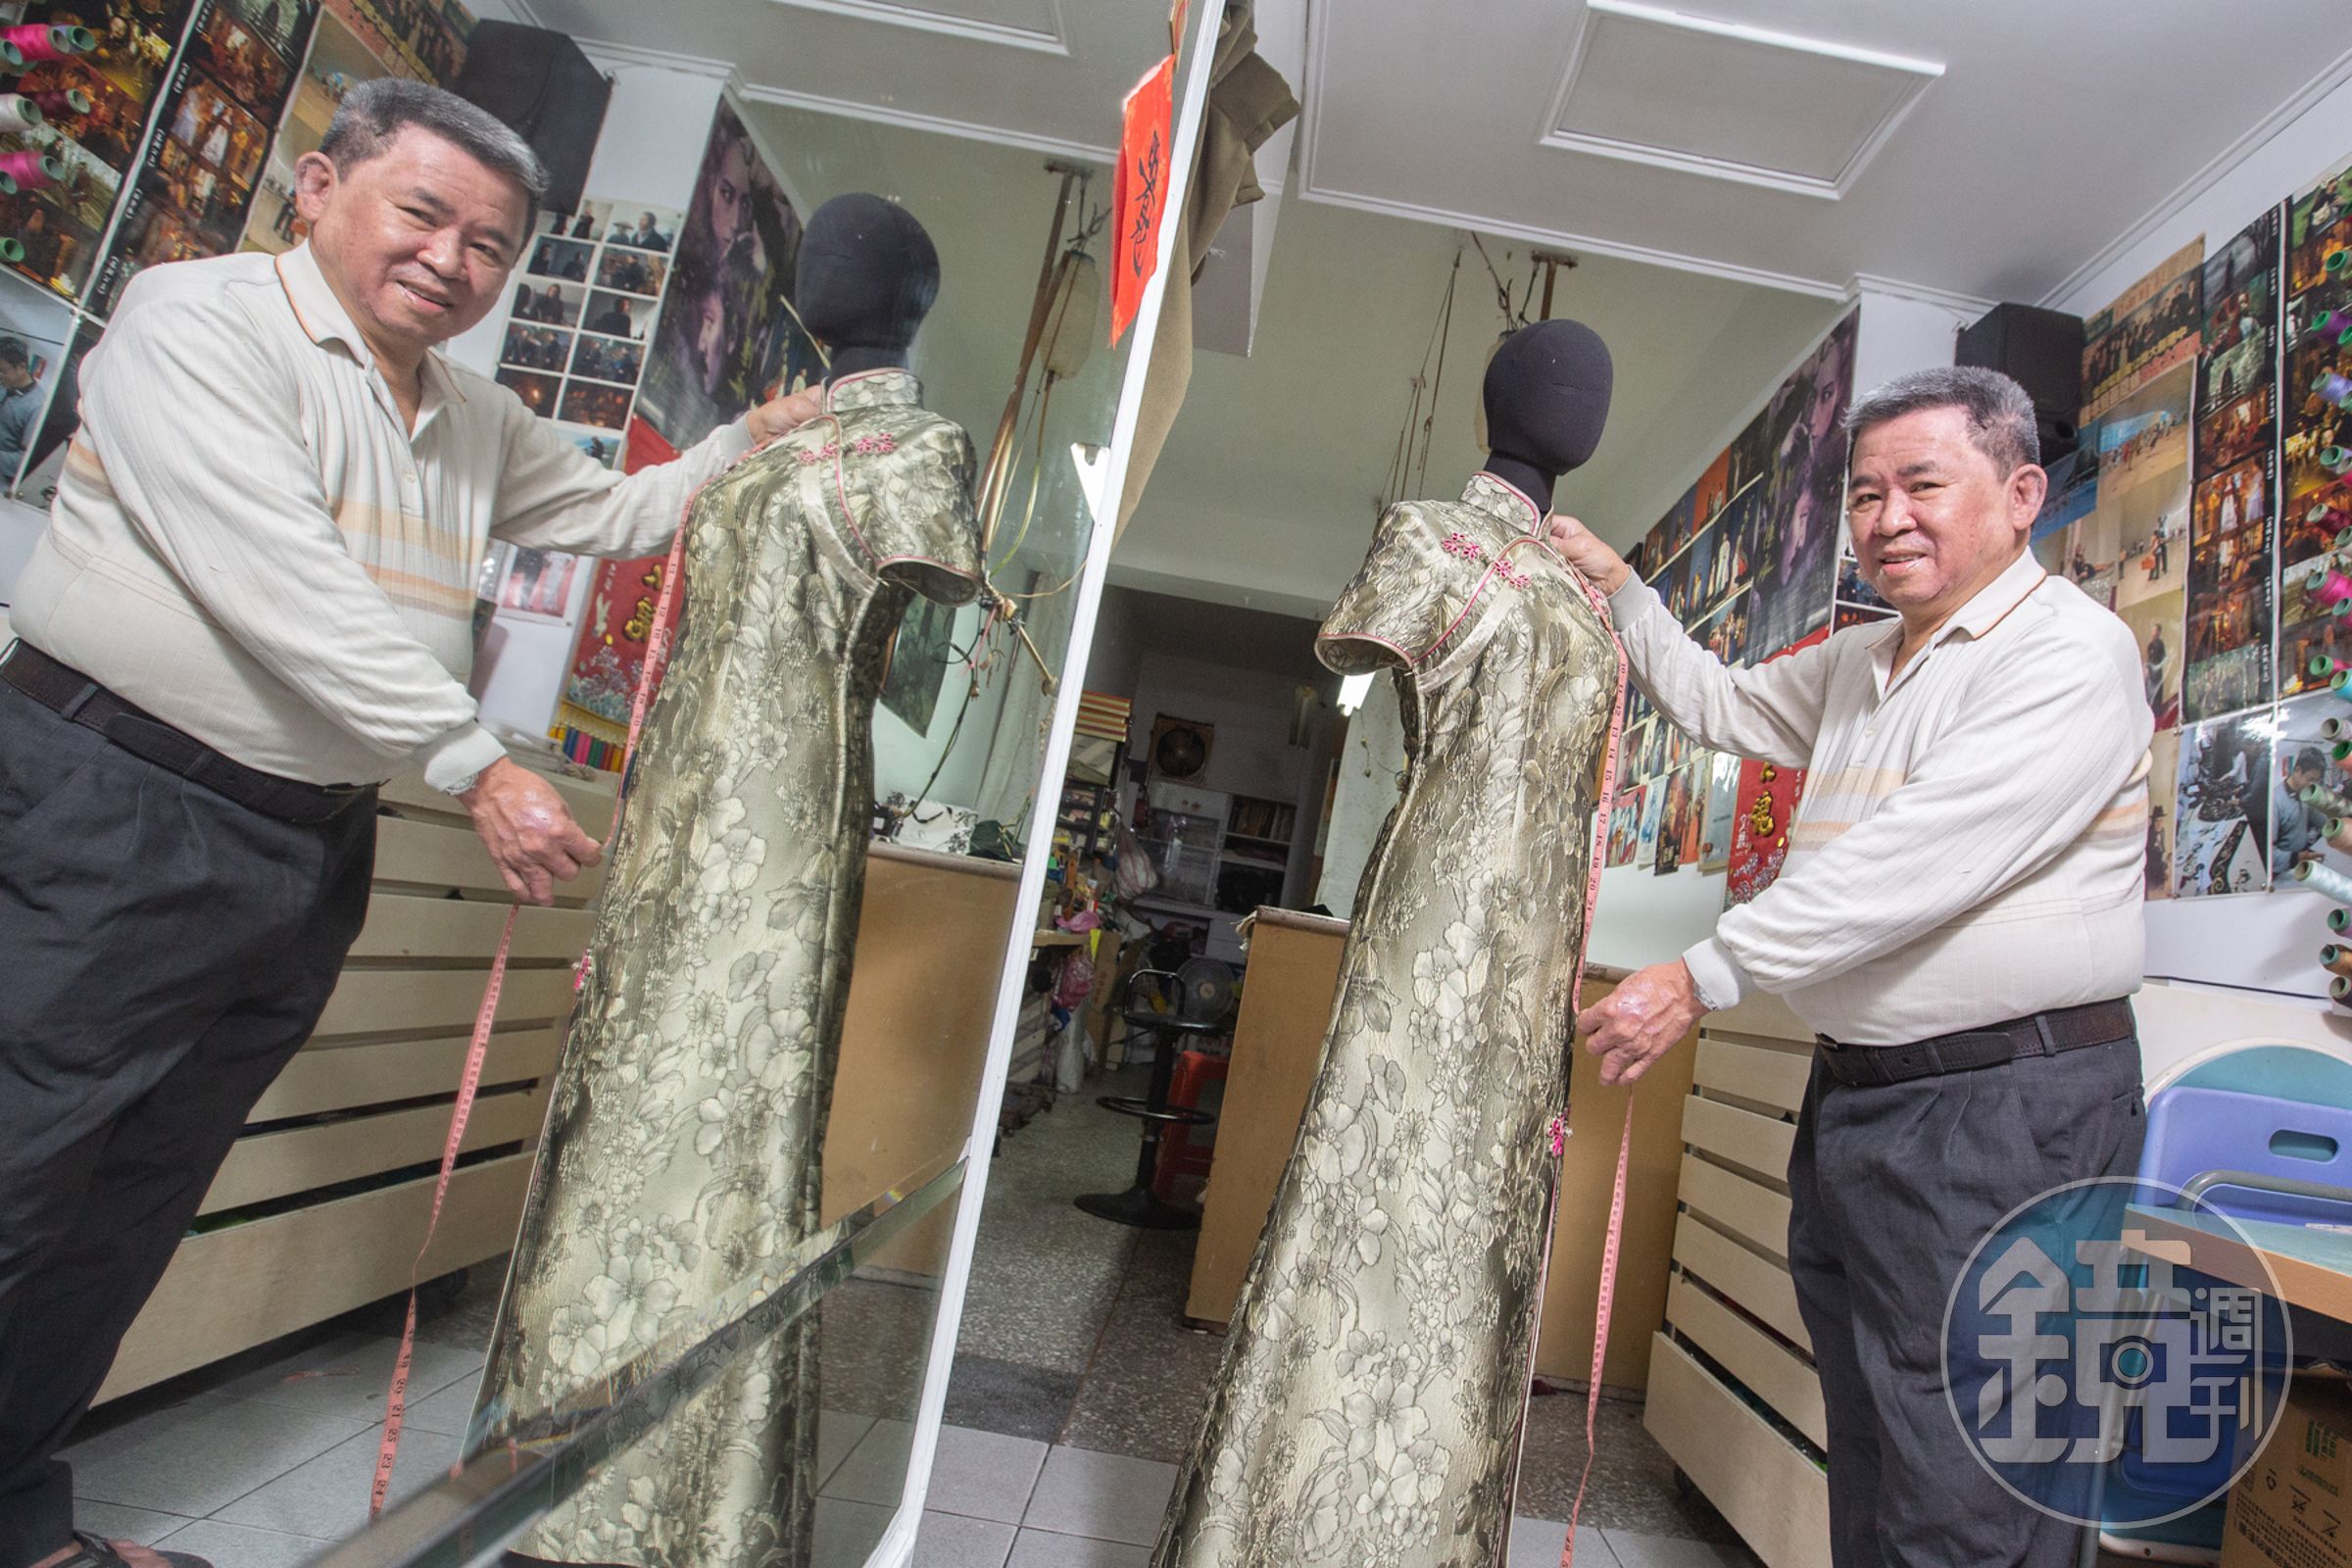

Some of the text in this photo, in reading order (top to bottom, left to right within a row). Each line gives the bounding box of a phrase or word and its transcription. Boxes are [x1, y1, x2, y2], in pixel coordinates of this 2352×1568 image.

[1621, 662, 1627, 674] 10
[1615, 706, 1621, 716] 12
[1611, 726, 1619, 738] 13
[1608, 748, 1616, 760] 14
[1604, 769, 1613, 782] 15
[1601, 791, 1610, 804] 16
[1598, 812, 1607, 825] 17
[1595, 834, 1603, 847] 18
[1592, 857, 1601, 869] 19
[1590, 877, 1597, 892] 20
[1587, 899, 1593, 911] 21
